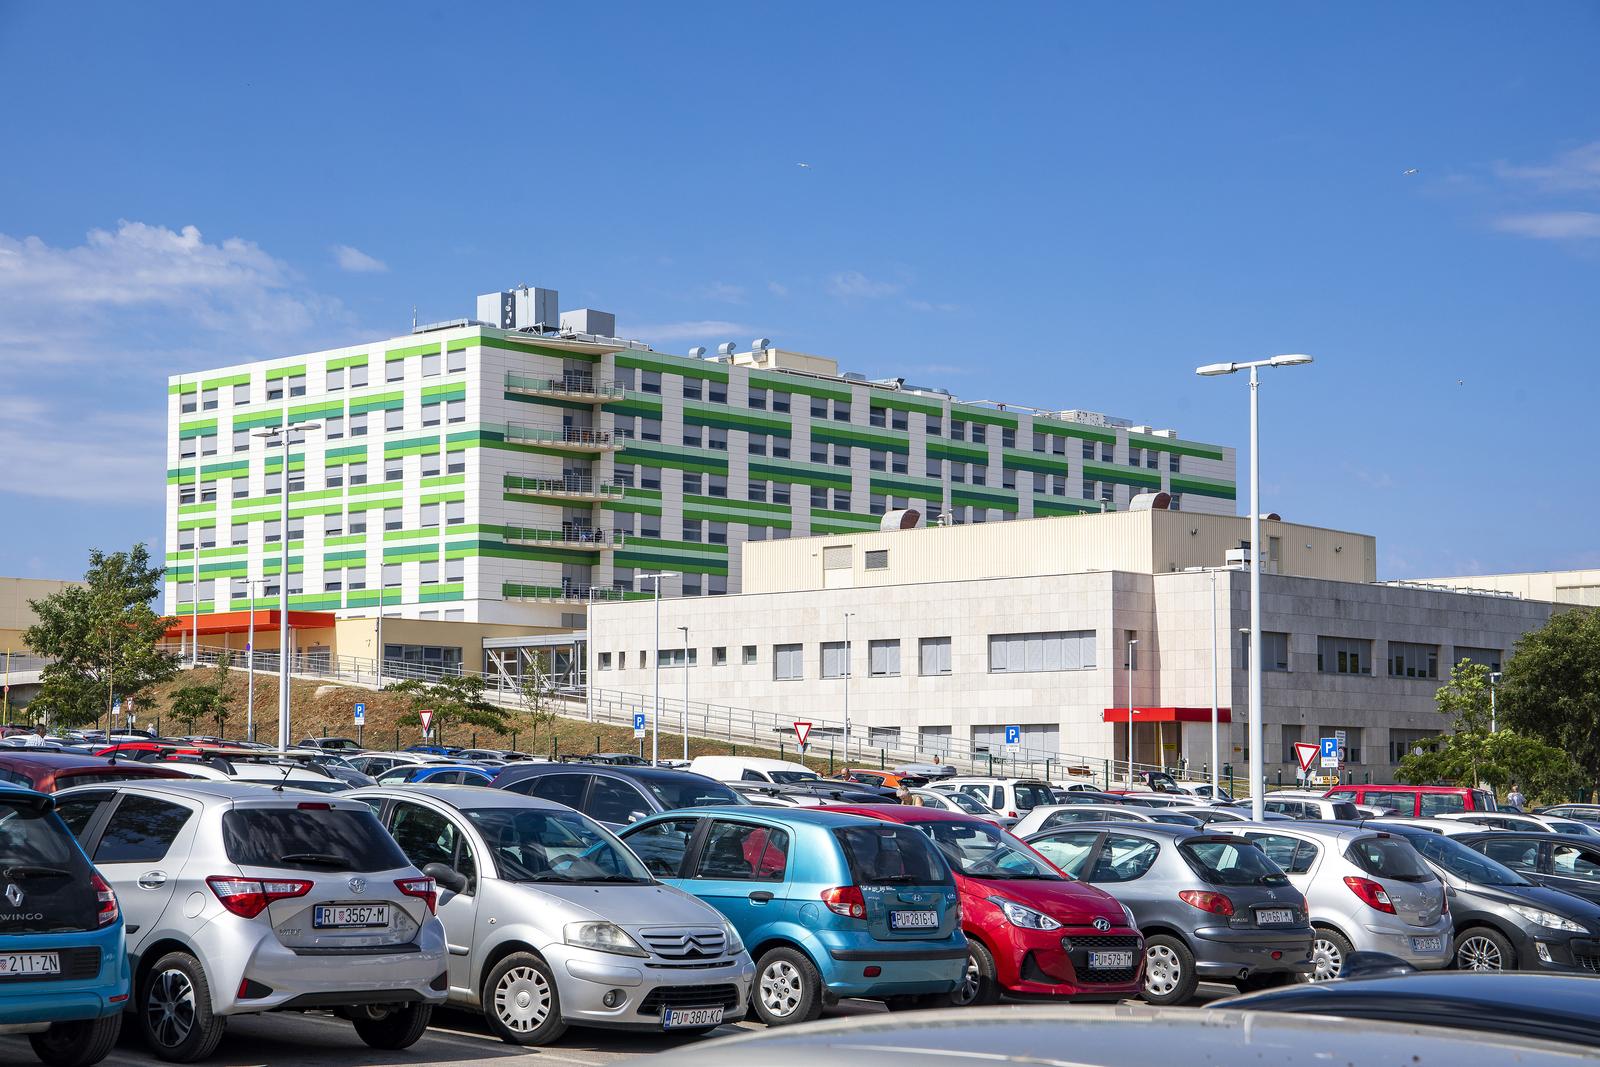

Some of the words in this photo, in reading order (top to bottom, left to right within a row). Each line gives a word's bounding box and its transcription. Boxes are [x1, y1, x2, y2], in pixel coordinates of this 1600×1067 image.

[637, 716, 642, 727] P
[1009, 729, 1016, 740] P
[1325, 741, 1333, 754] P
[323, 908, 336, 923] RI
[345, 907, 384, 923] 3567-M
[896, 913, 907, 926] PU
[9, 955, 58, 972] 211-ZN
[671, 1011, 684, 1025] PU
[689, 1009, 722, 1024] 380-KC
